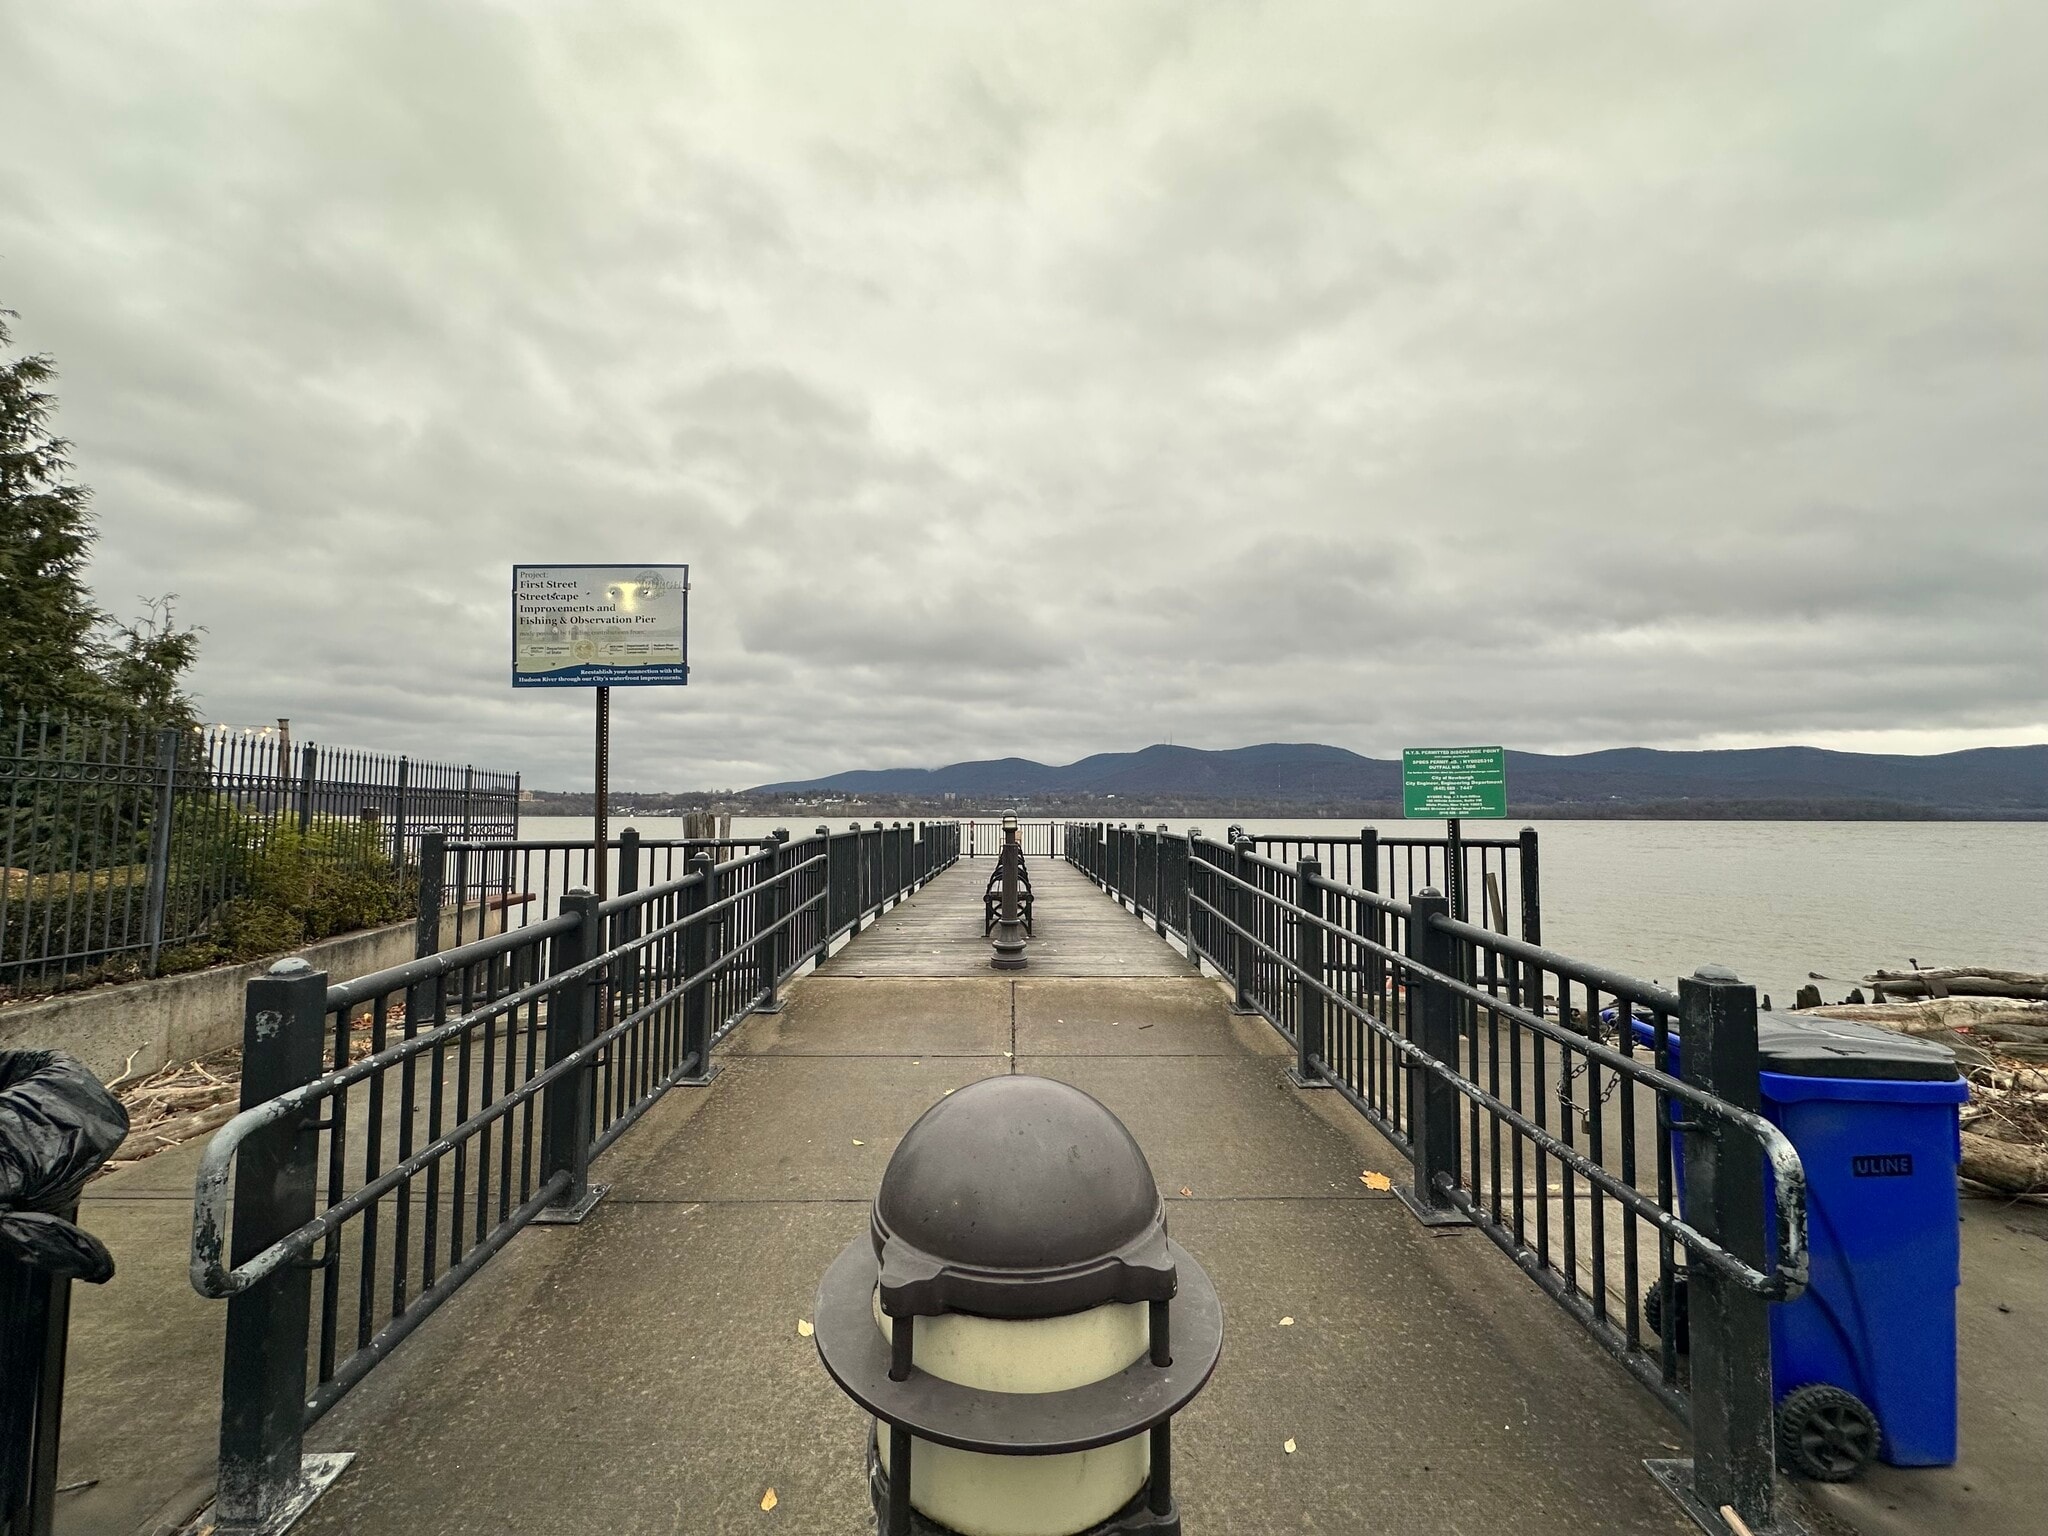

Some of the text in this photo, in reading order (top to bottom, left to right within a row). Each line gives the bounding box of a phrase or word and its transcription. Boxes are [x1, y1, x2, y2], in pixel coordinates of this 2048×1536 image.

[520, 571, 548, 579] Project:
[520, 580, 577, 589] First Street
[519, 592, 579, 601] Streetscape
[520, 603, 616, 614] Improvements and
[520, 614, 657, 627] Fishing & Observation Pier
[1856, 1158, 1909, 1174] ULINE
